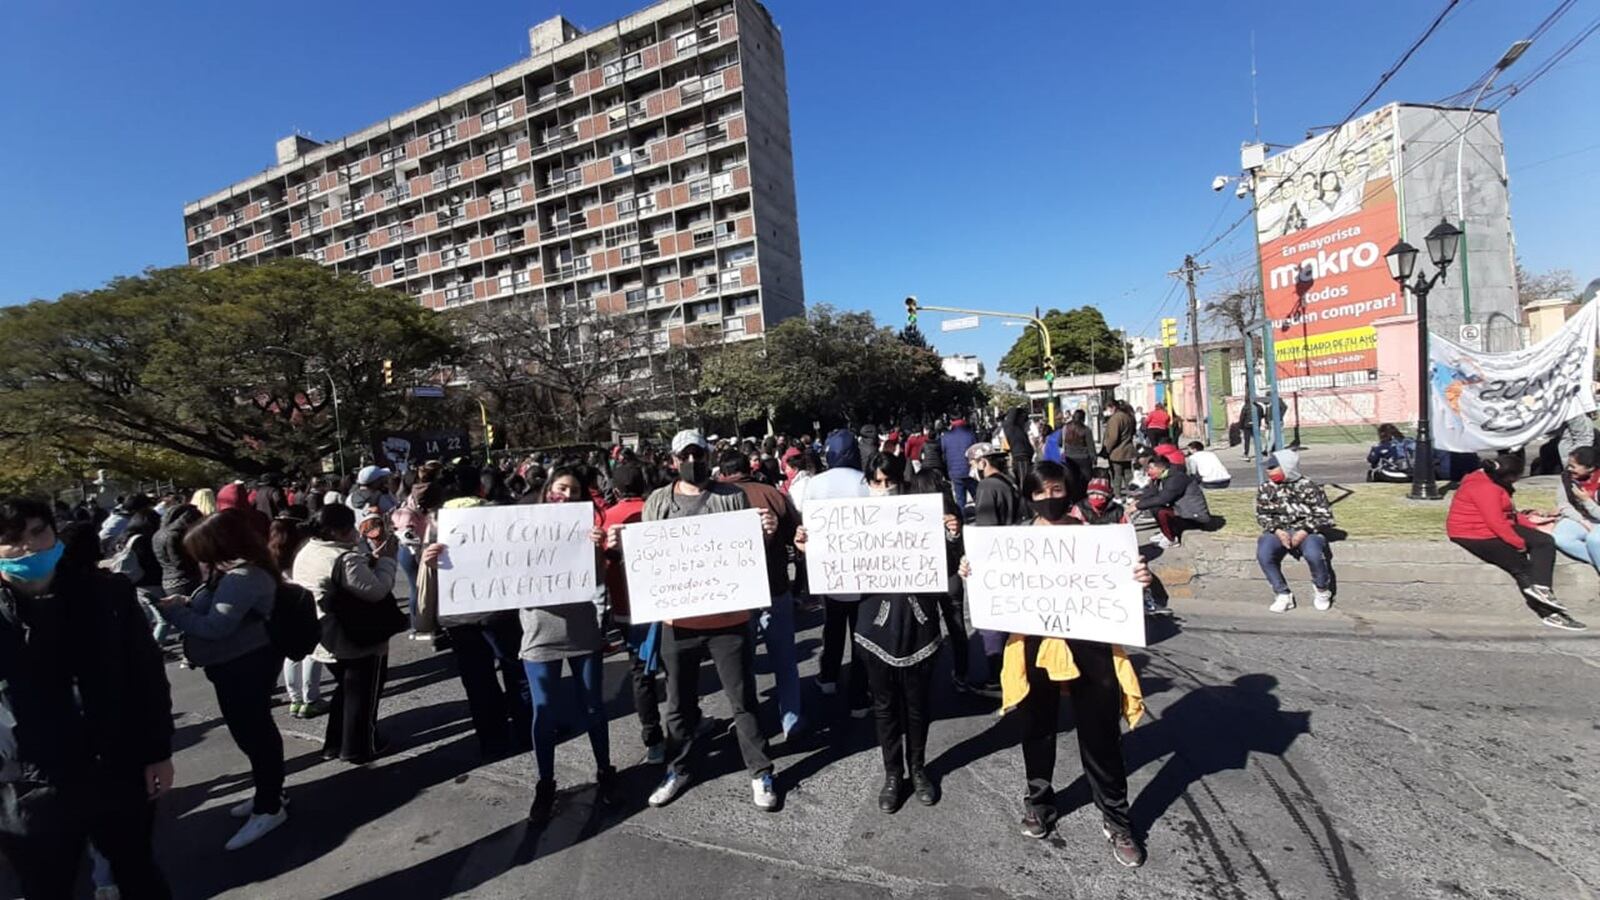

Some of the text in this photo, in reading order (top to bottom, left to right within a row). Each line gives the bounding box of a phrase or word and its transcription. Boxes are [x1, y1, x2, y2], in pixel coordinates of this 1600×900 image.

[1282, 226, 1361, 257] En mayorista
[1270, 242, 1379, 290] makro
[1305, 284, 1348, 304] todos
[1321, 293, 1397, 317] comprar!
[426, 437, 461, 453] LA 22
[810, 504, 924, 533] SAENZ ES
[451, 519, 583, 545] SIN COMIDA
[827, 530, 931, 553] RESPONSABLE
[730, 539, 753, 550] con
[987, 535, 1132, 567] ABRAN LOS
[487, 547, 558, 568] NO HAY
[651, 552, 757, 579] la plata de los
[822, 554, 937, 577] DEL HAMBRE DE
[451, 569, 590, 602] CUARENTENA
[649, 577, 721, 597] comedores
[827, 571, 939, 591] LA PROVINCIA
[984, 569, 1117, 591] COMEDORES
[991, 595, 1128, 624] ESCOLARES
[1038, 614, 1071, 633] YA!
